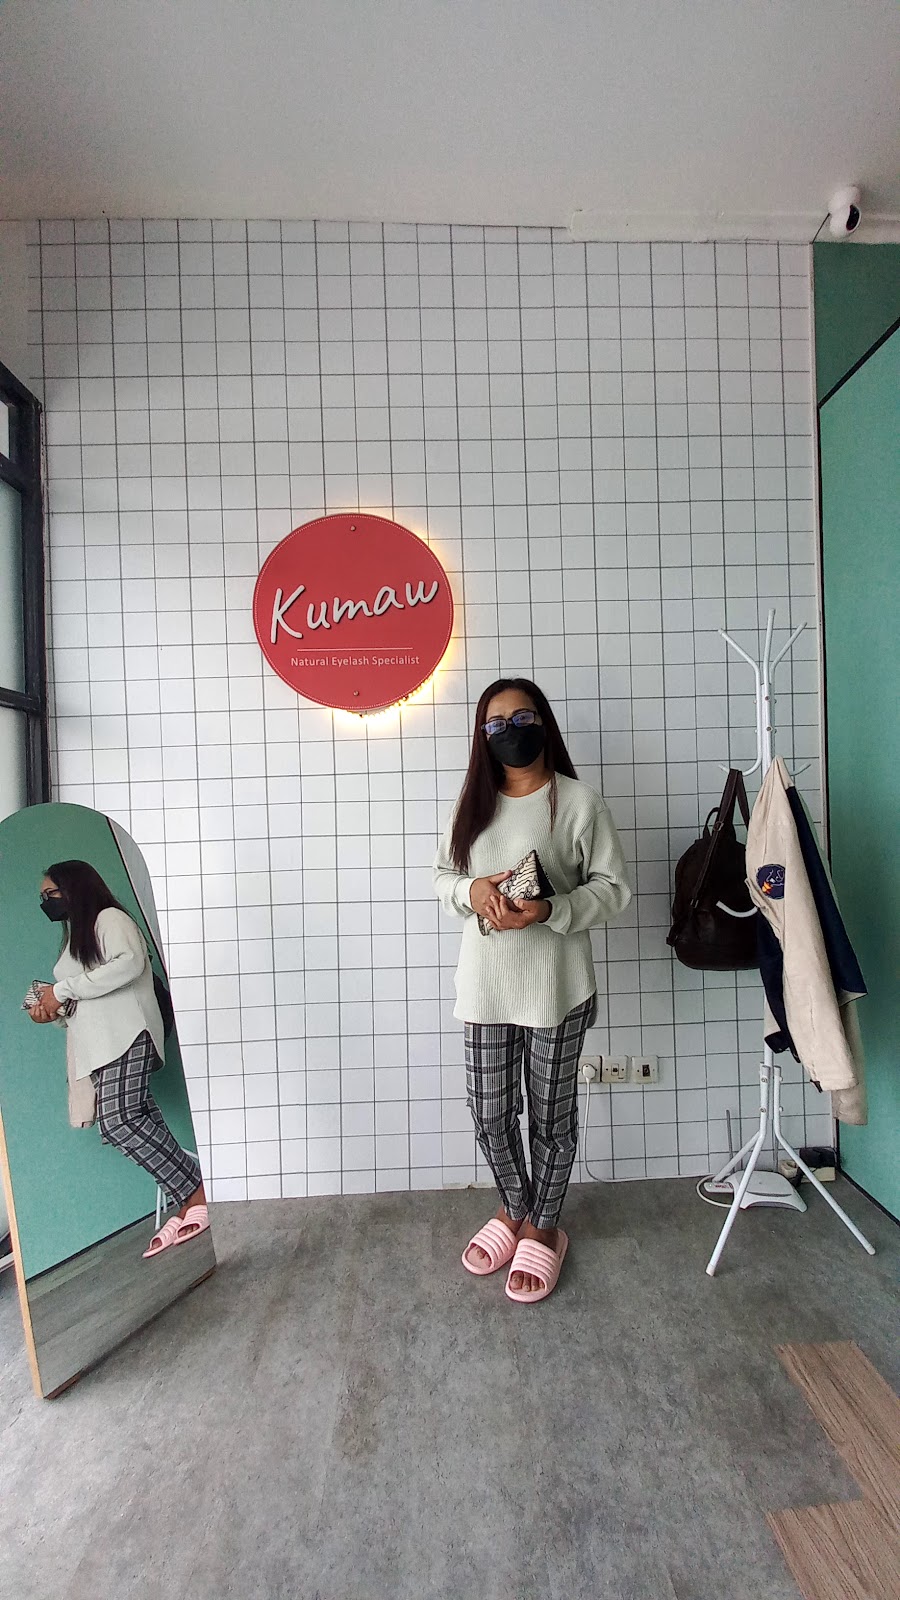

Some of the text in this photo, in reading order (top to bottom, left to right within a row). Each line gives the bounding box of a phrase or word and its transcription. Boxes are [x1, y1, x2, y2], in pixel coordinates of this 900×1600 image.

[270, 580, 439, 644] Kumaw
[291, 655, 420, 668] Natural Eyelash Specialist
